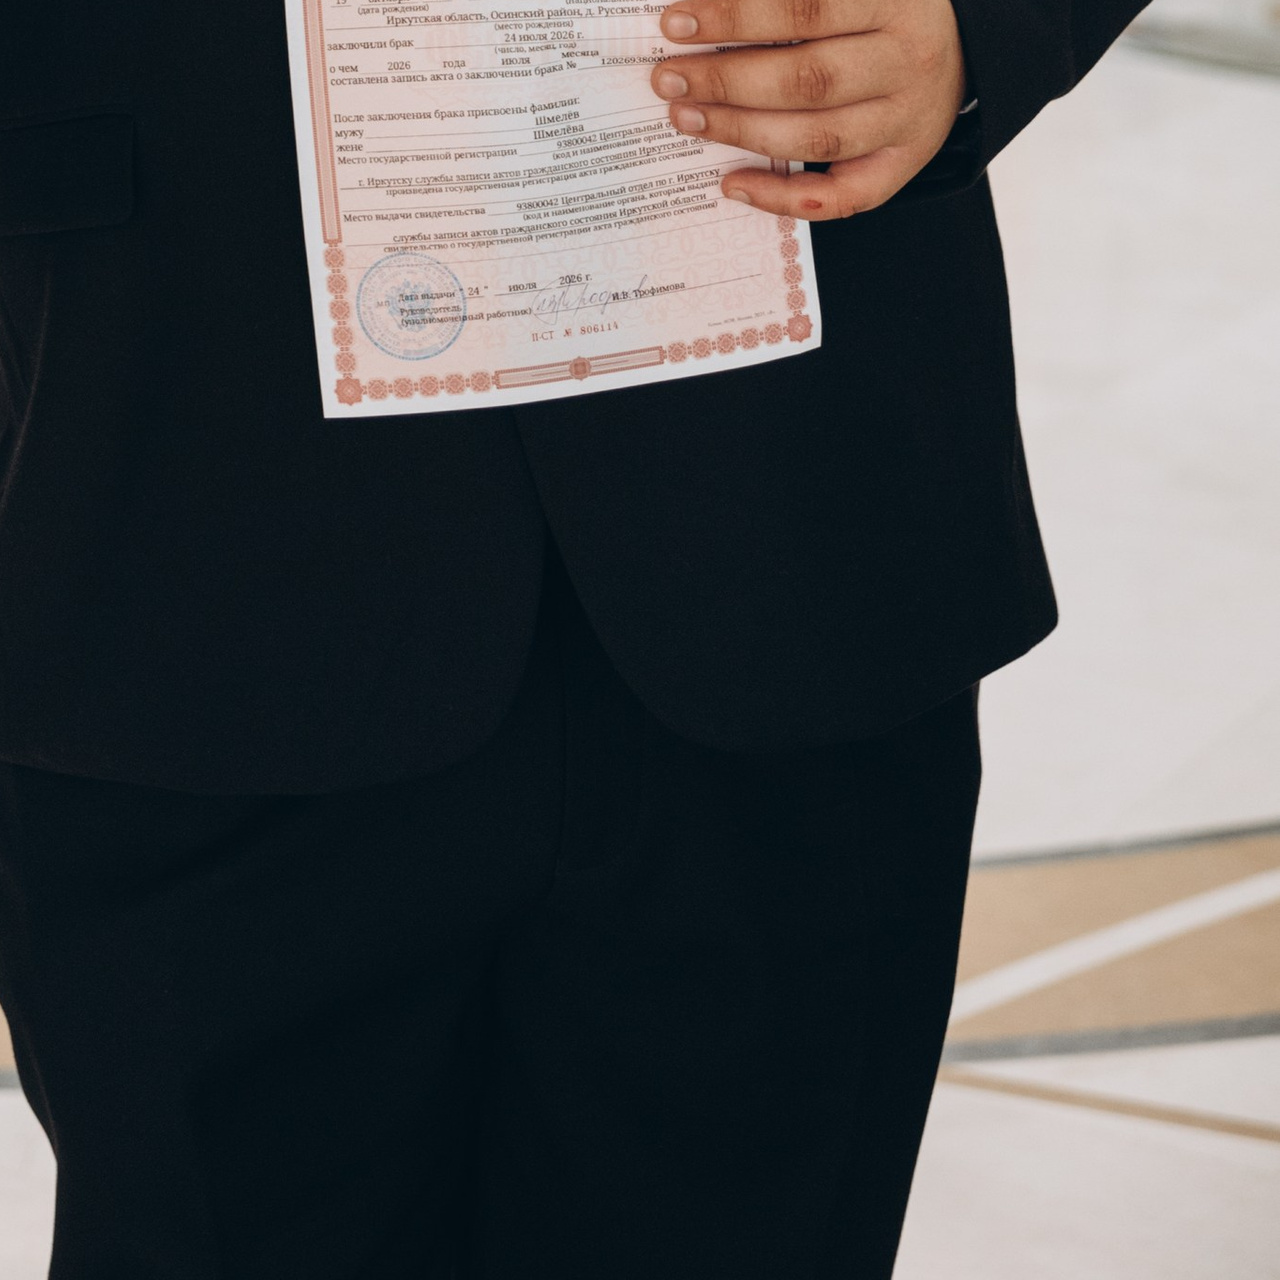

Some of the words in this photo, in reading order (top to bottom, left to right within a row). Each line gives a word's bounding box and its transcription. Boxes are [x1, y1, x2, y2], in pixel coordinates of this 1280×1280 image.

[387, 14, 442, 26] Иркутская
[445, 12, 488, 22] область,
[491, 7, 544, 19] Осинский
[547, 7, 582, 19] район,
[327, 41, 387, 51] заключили
[389, 39, 414, 50] брак
[504, 33, 516, 42] 24
[519, 33, 547, 42] июля
[550, 31, 575, 40] 2026
[529, 43, 556, 53] месяц,
[339, 65, 358, 73] чем
[387, 61, 411, 70] 2026
[442, 60, 465, 69] года
[501, 57, 530, 66] июля
[561, 49, 599, 59] месяца
[651, 47, 663, 55] 24
[330, 76, 388, 86] составлена
[391, 74, 427, 83] запись
[430, 73, 454, 81] акта
[465, 68, 532, 79] заключении
[534, 62, 564, 75] брака
[566, 61, 577, 70] №
[334, 113, 364, 123] После
[367, 111, 432, 121] заключения
[434, 108, 465, 120] брака
[467, 105, 527, 117] присвоены
[529, 97, 580, 114] фамилии:
[335, 128, 364, 138] мужу
[535, 110, 580, 126] Шмелёв
[336, 144, 363, 152] жене
[533, 124, 584, 140] Шмелёва
[337, 155, 367, 165] Место
[369, 152, 451, 165] государственной
[454, 148, 517, 160] регистрации
[556, 134, 597, 149] 93800042
[599, 121, 669, 142] Центральный
[580, 137, 642, 155] наименование
[643, 130, 675, 144] органа,
[367, 176, 413, 188] Иркутску
[415, 173, 453, 185] службы
[456, 171, 490, 180] записи
[493, 169, 520, 178] актов
[523, 161, 589, 176] гражданского
[590, 150, 637, 167] состояния
[639, 139, 688, 157] Иркутской
[386, 185, 443, 196] произведена
[445, 180, 520, 193] государственная
[522, 173, 577, 188] регистрация
[579, 168, 597, 177] акта
[599, 157, 656, 174] гражданского
[343, 212, 373, 222] Место
[375, 210, 412, 221] выдачи
[414, 207, 485, 219] свидетельства
[517, 199, 559, 211] 93800042
[561, 186, 626, 204] Центральный
[628, 181, 654, 193] отдел
[677, 168, 720, 184] Иркутску
[551, 200, 615, 216] наименование
[617, 194, 647, 206] органа,
[649, 187, 686, 200] которым
[687, 180, 719, 191] выдано
[393, 232, 431, 243] службы
[433, 231, 468, 240] записи
[470, 229, 498, 237] актов
[500, 220, 567, 236] гражданского
[570, 212, 617, 225] состояния
[619, 202, 668, 218] Иркутской
[670, 193, 706, 206] области
[383, 243, 449, 253] свидетельство
[457, 236, 533, 249] государственной
[536, 228, 591, 242] регистрации
[593, 223, 611, 232] акта
[613, 212, 672, 227] гражданского
[467, 286, 480, 296] 24
[508, 282, 537, 292] июля
[559, 273, 583, 285] 2026
[633, 282, 685, 298] Трофимова
[580, 321, 619, 335] 806114
